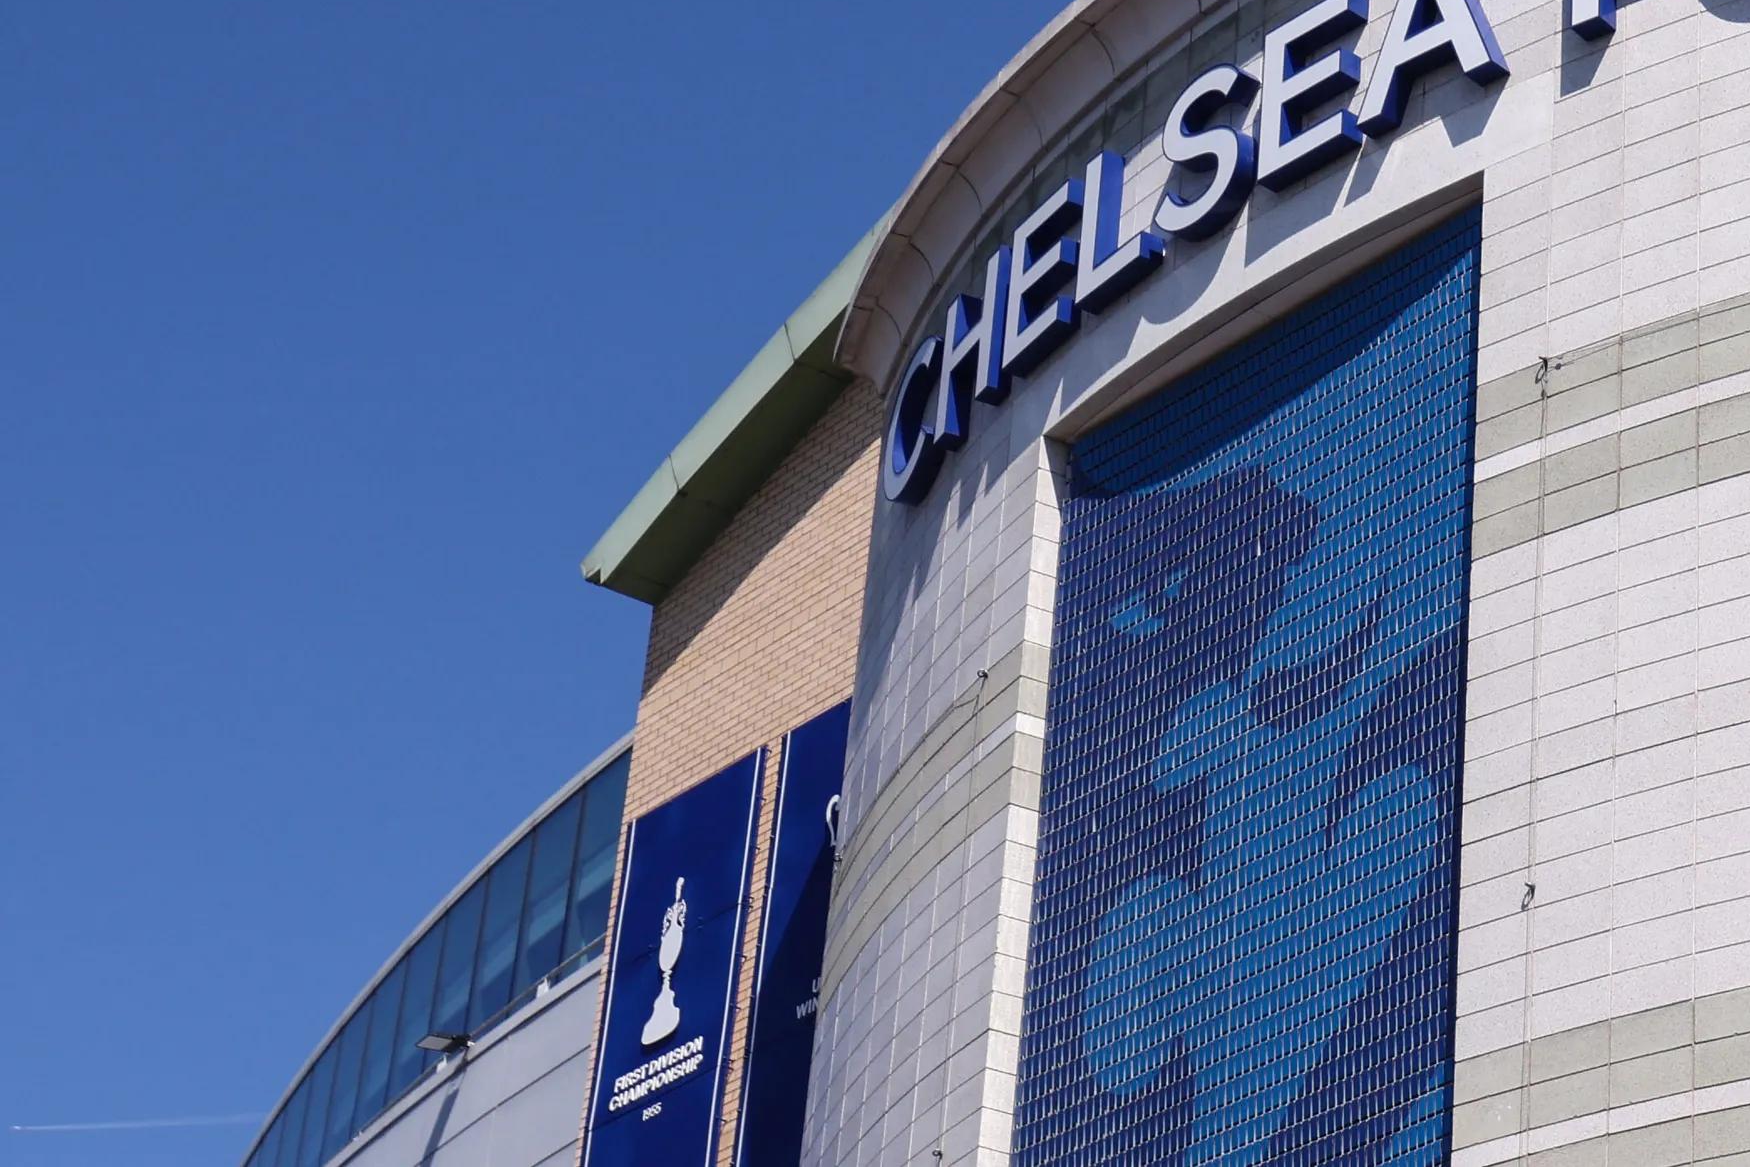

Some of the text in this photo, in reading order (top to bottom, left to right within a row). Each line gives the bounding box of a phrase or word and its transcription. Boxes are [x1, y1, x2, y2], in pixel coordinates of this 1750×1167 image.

[608, 1053, 704, 1111] CHAMPIONSHIP
[614, 1035, 704, 1093] FIRST DIVISION
[642, 1102, 662, 1121] 1955
